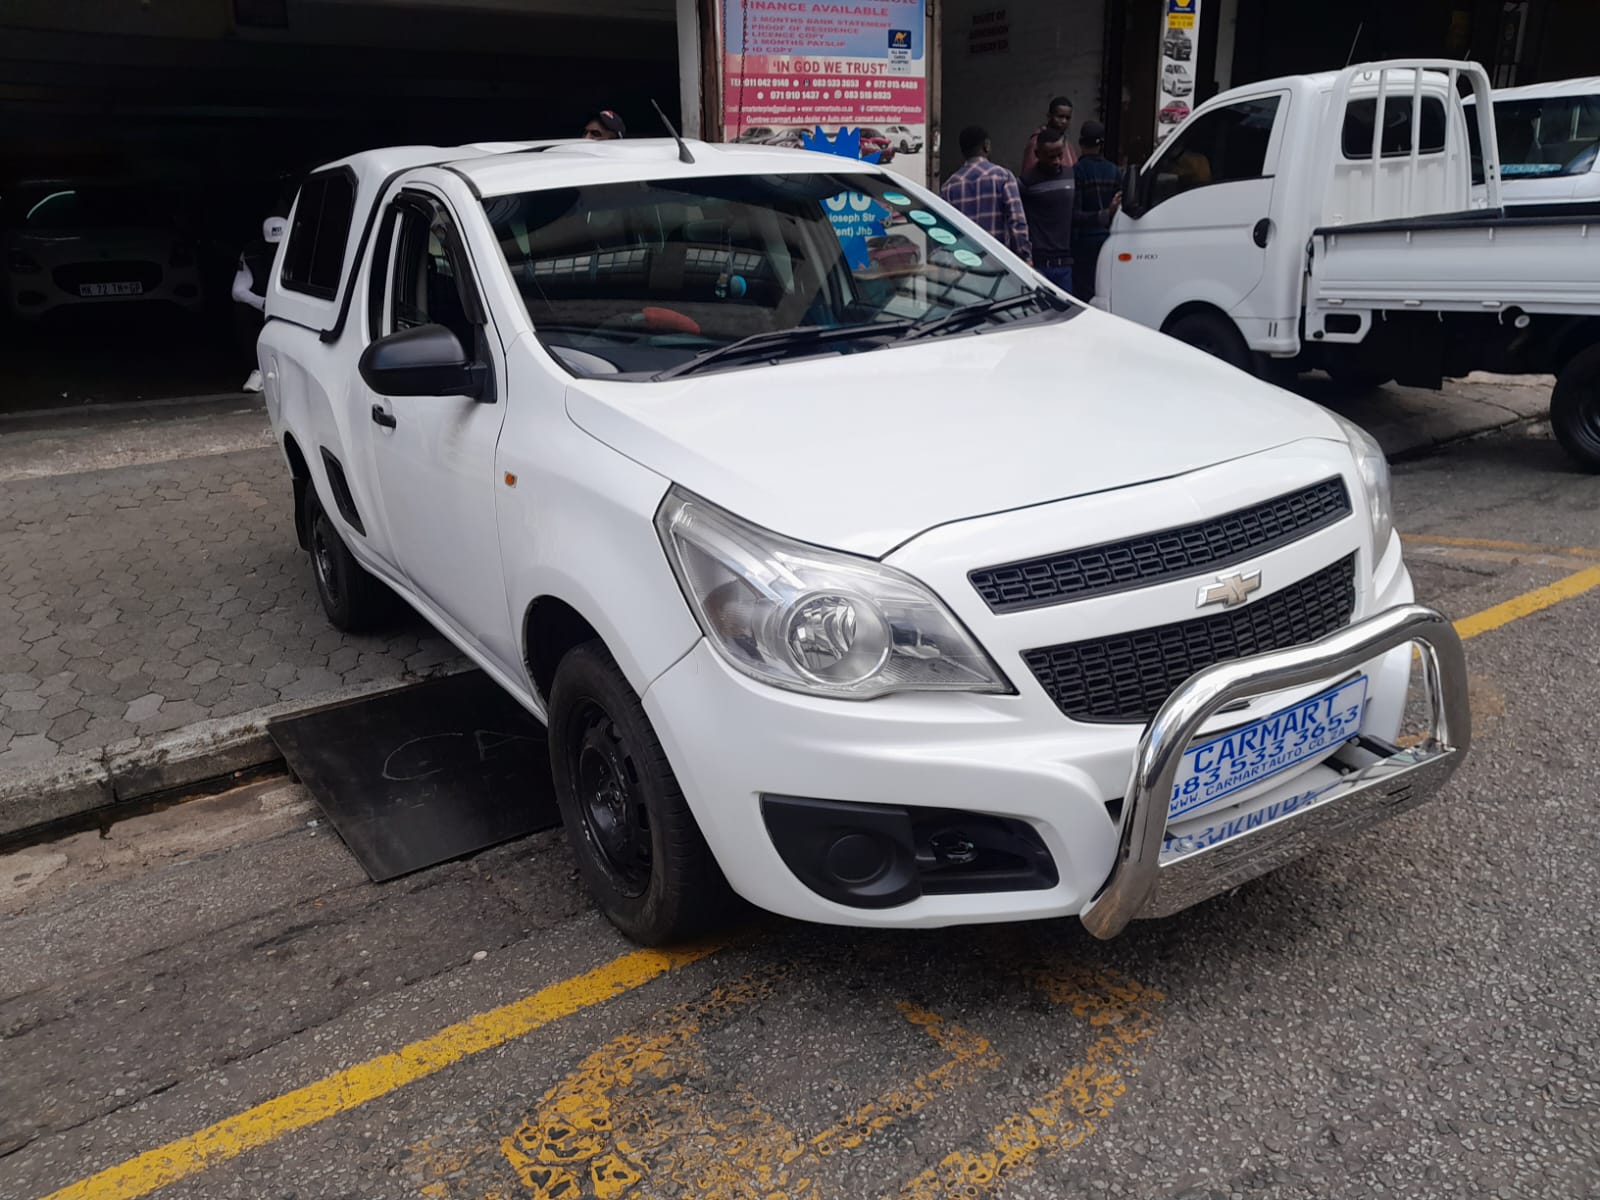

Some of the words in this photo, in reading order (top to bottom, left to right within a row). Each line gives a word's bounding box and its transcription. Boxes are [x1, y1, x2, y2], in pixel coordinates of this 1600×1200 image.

[741, 2, 806, 13] FINANCE
[811, 5, 889, 16] AVAILABLE
[837, 19, 892, 28] STATEMENT
[804, 26, 859, 34] RESIDENCE
[807, 40, 846, 48] PAYSLIP
[793, 60, 820, 74] GOD
[823, 61, 842, 75] WE
[862, 212, 876, 223] Str
[855, 225, 873, 237] Jhb
[1193, 692, 1340, 775] CARMART
[1230, 738, 1285, 776] 533
[1293, 704, 1360, 748] 3653
